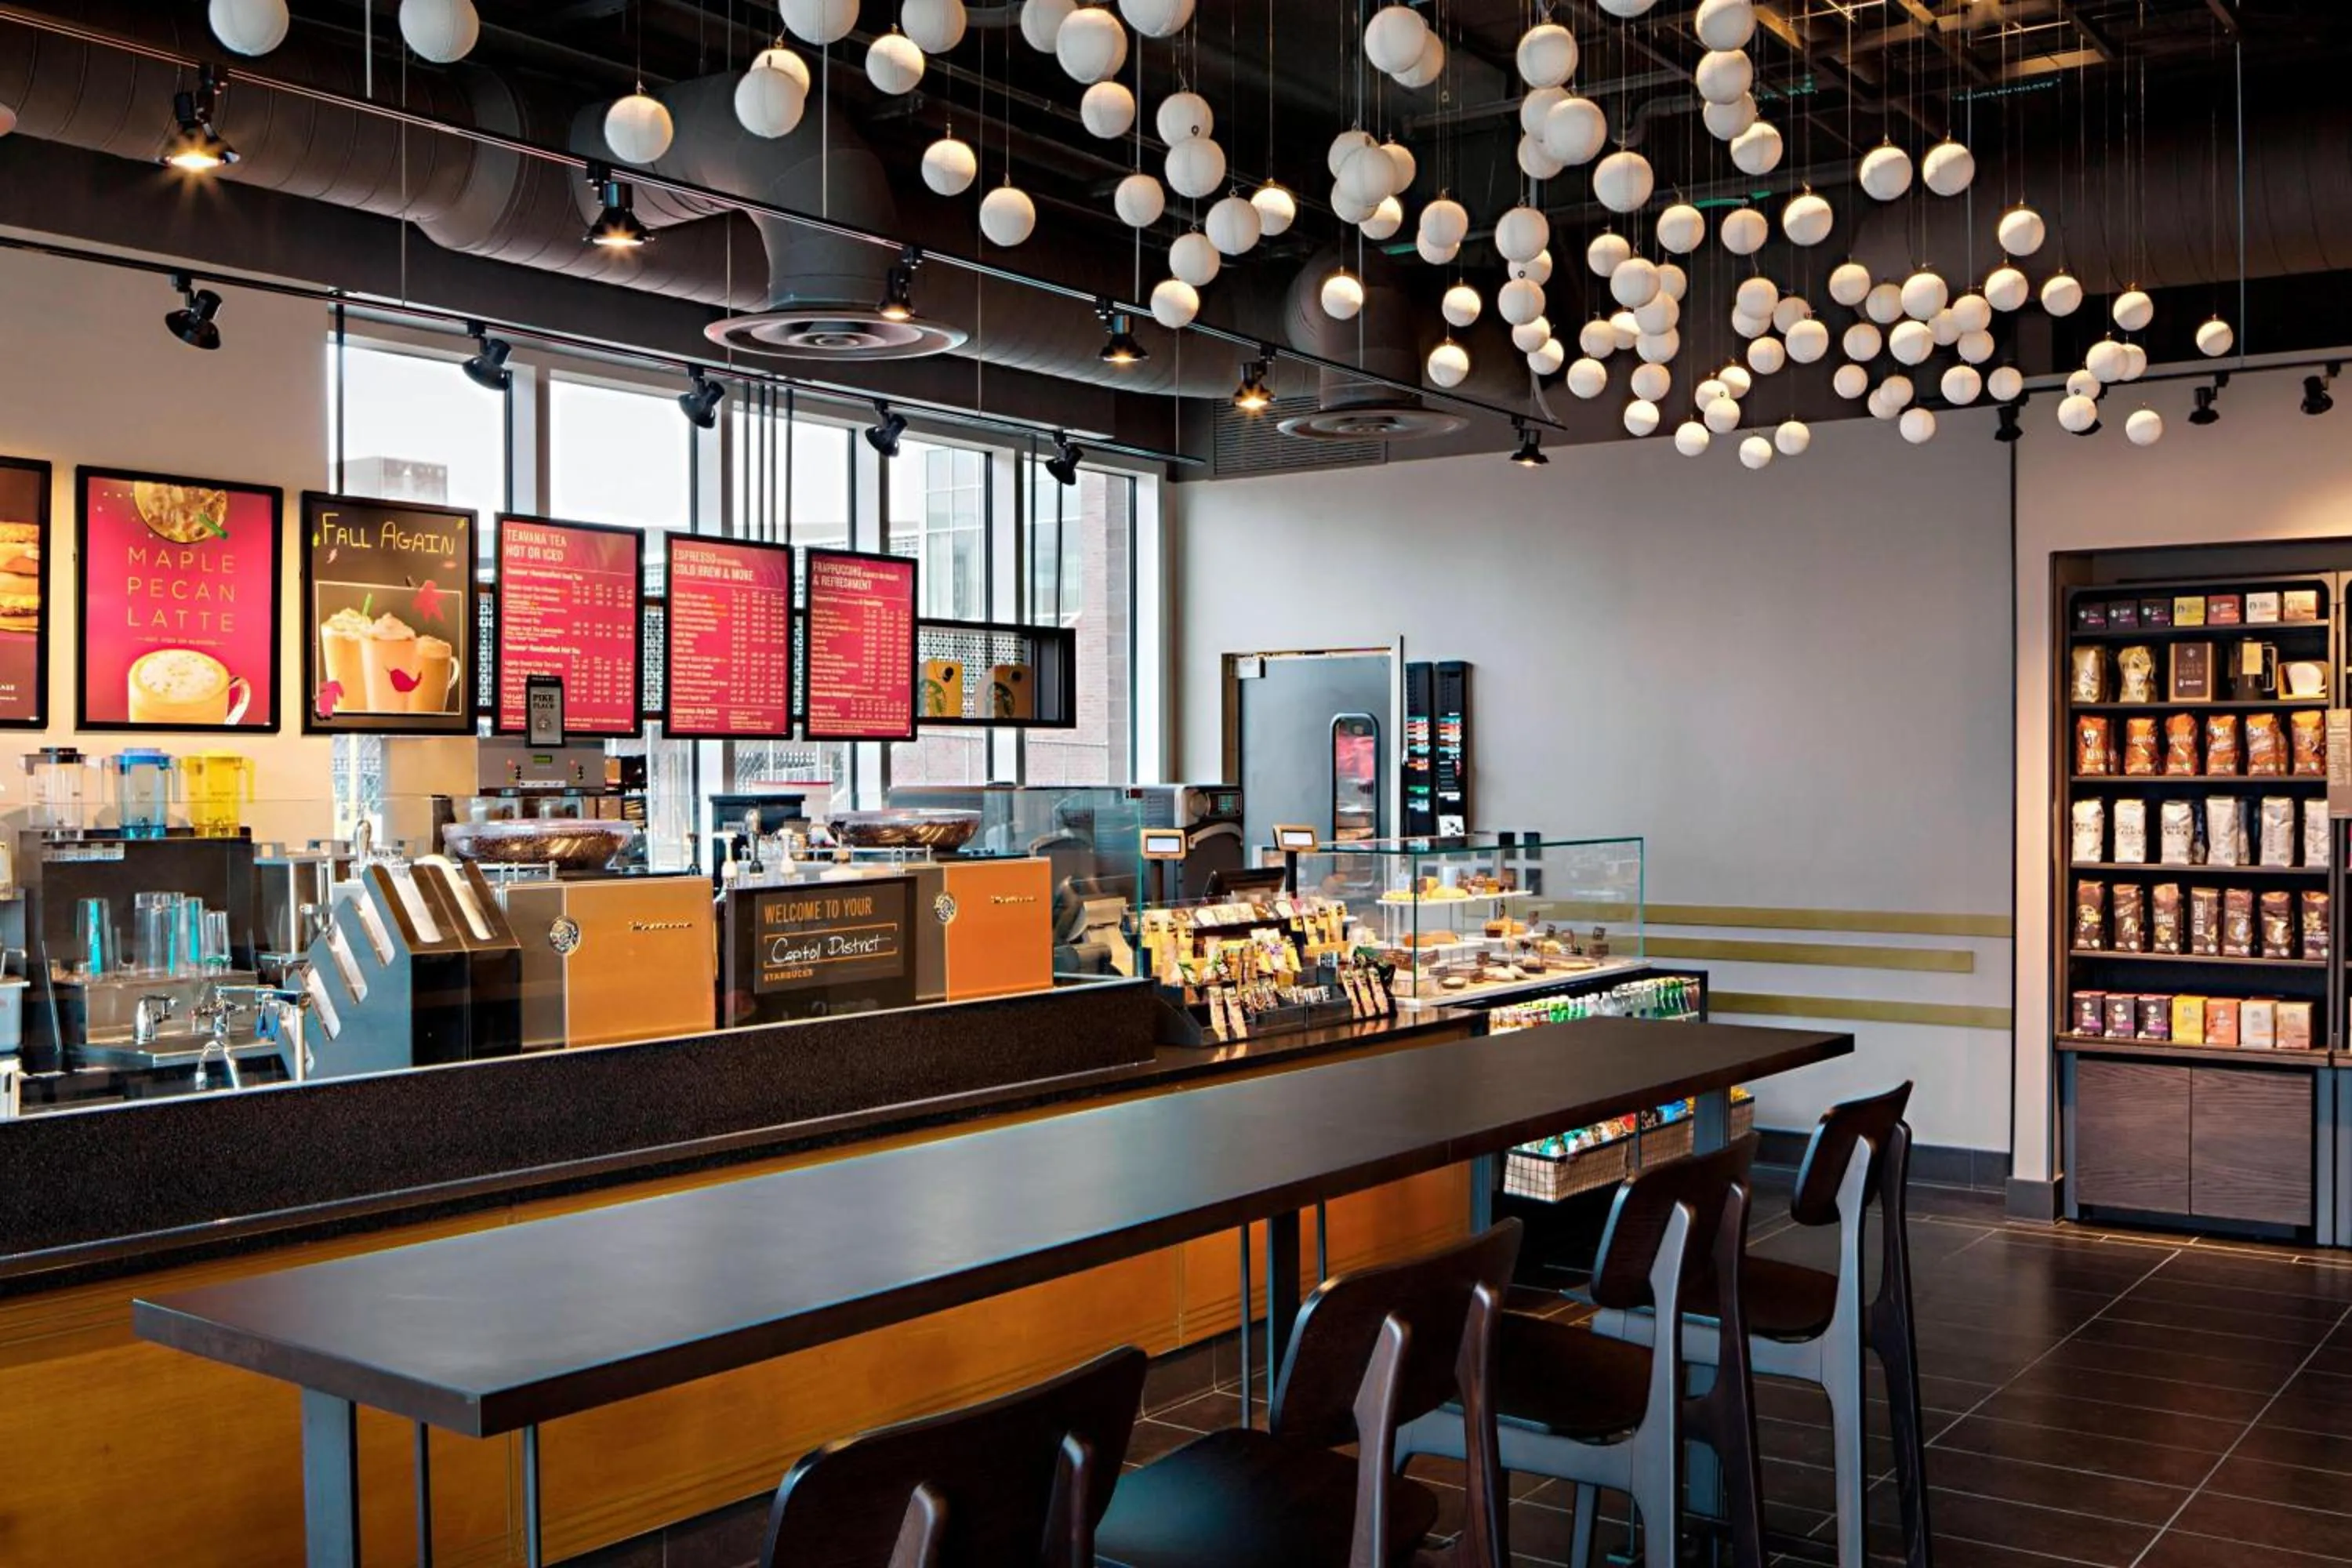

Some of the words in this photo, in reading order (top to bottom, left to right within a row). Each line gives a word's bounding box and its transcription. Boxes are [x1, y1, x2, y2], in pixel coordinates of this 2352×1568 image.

[506, 529, 547, 545] TEAVANA
[550, 534, 568, 547] TEA
[128, 546, 235, 574] MAPLE
[506, 544, 526, 558] HOT
[528, 546, 541, 559] OR
[542, 548, 564, 562] ICED
[674, 549, 716, 564] ESPRESSO
[673, 563, 695, 576] COLD
[698, 564, 721, 579] BREW
[731, 568, 754, 582] MORE
[128, 576, 235, 603] PECAN
[128, 607, 235, 633] LATTE
[764, 901, 822, 924] WELCOME
[826, 899, 840, 919] TO
[844, 896, 873, 916] YOUR
[764, 968, 814, 983] STARBUCKS
